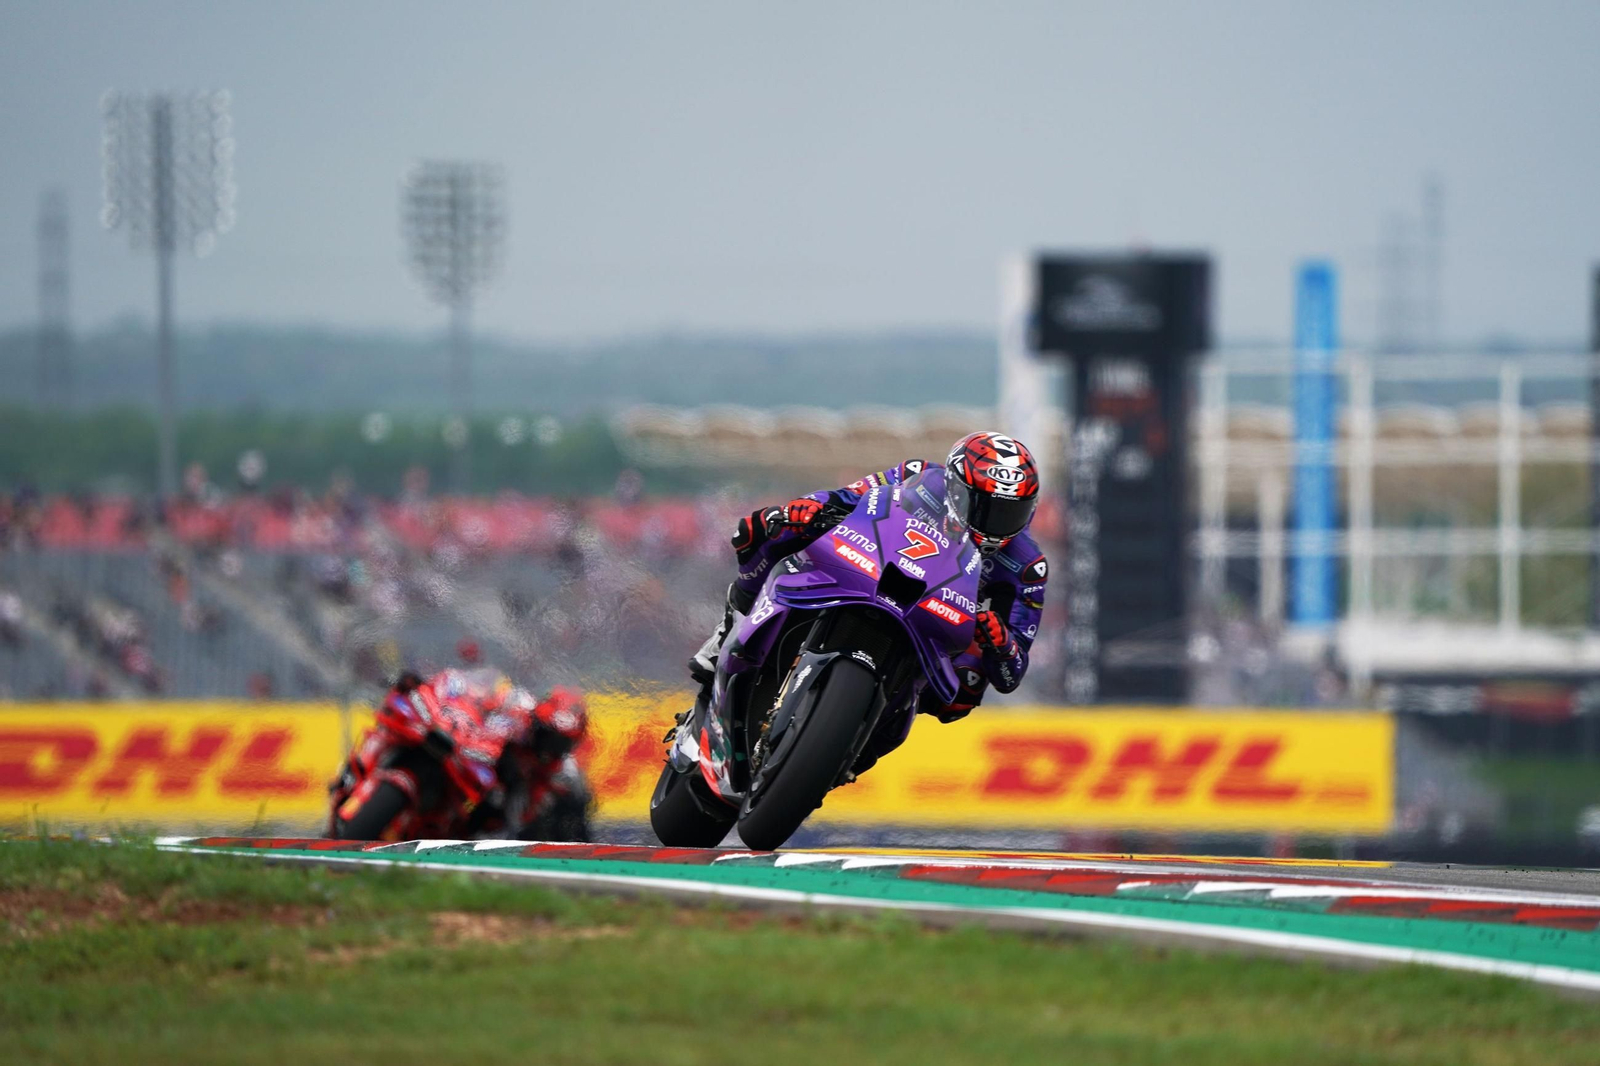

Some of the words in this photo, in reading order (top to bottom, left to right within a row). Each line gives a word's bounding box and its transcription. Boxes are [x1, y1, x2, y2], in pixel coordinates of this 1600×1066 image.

[988, 467, 1023, 481] KYT
[832, 524, 878, 553] prima
[896, 528, 940, 560] 7
[905, 518, 950, 549] prima
[836, 544, 877, 573] MOTUL
[898, 557, 926, 580] FIAMM
[926, 599, 961, 624] MOTUL
[941, 587, 977, 614] prima
[0, 724, 309, 796] DHL
[982, 733, 1299, 799] DHL
